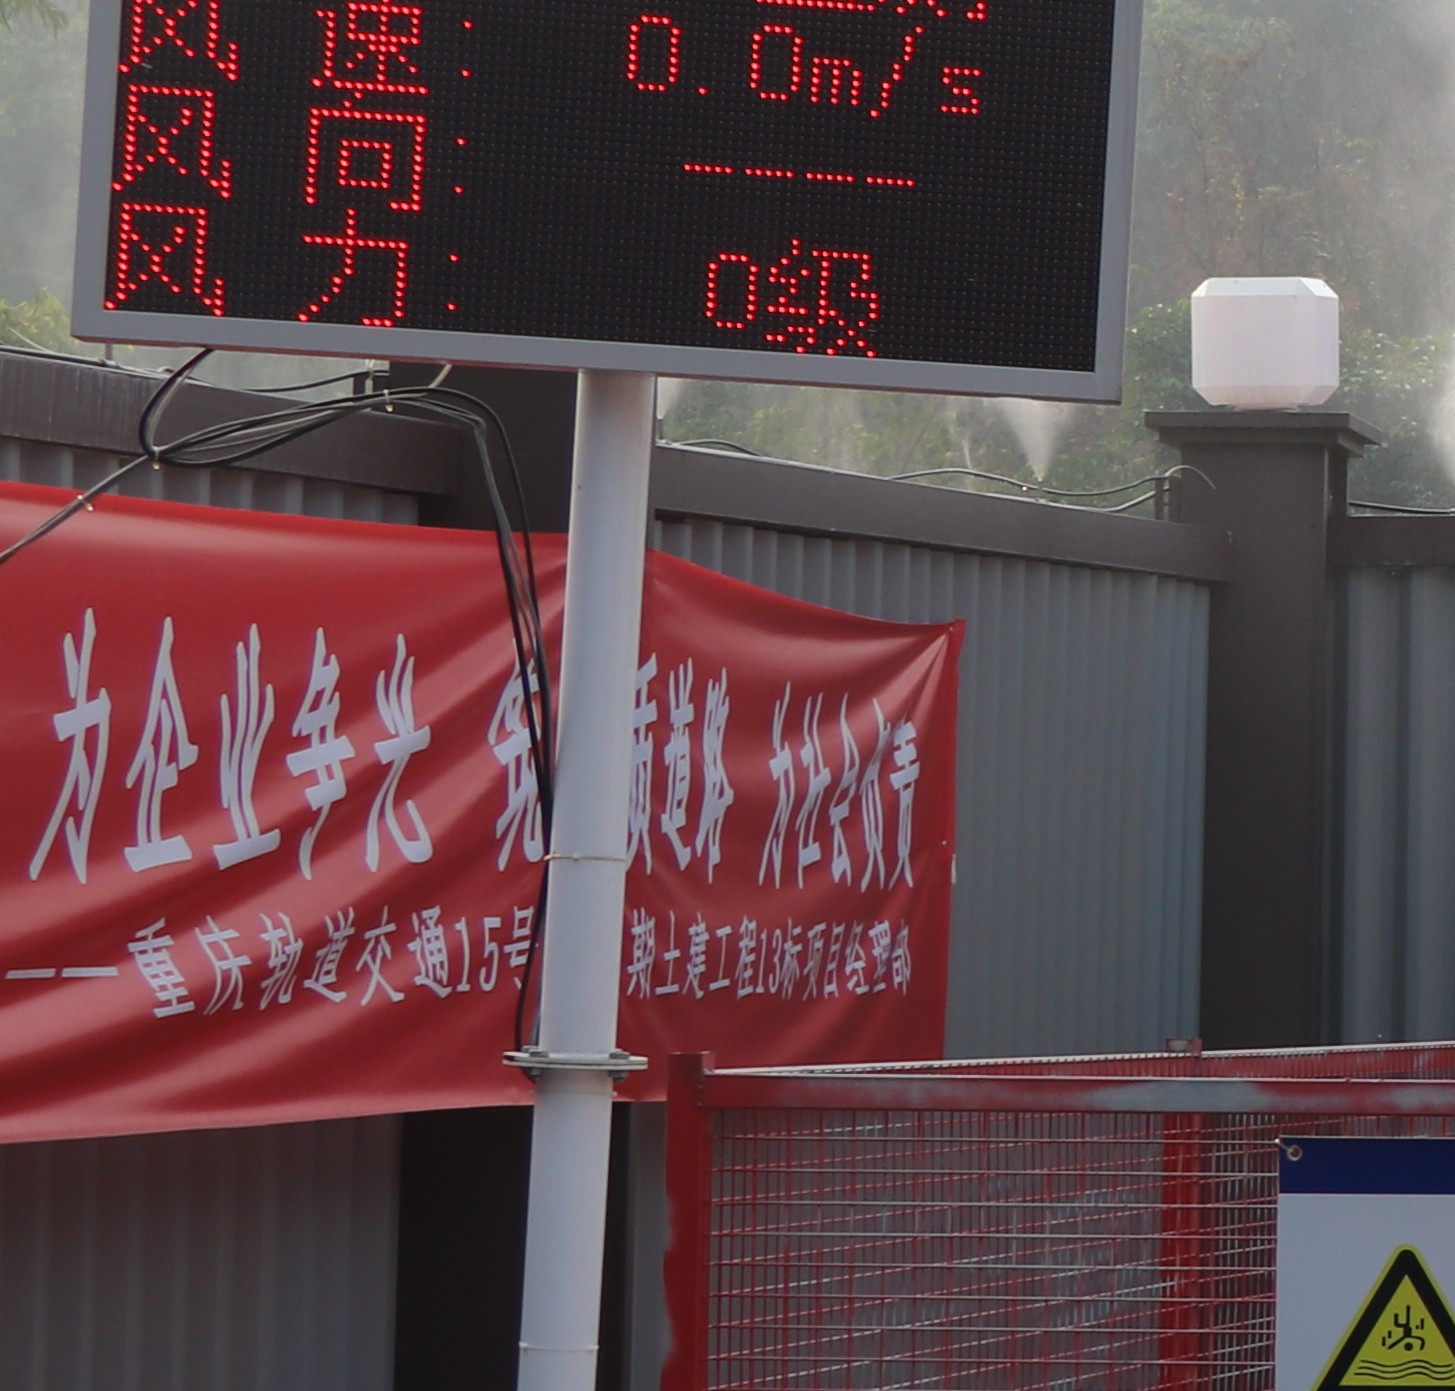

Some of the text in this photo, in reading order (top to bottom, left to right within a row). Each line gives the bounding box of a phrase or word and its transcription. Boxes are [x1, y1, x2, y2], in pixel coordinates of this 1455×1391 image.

[704, 238, 880, 360] 0级
[29, 608, 920, 893] 为企业争光 筑质道路 为社会负责
